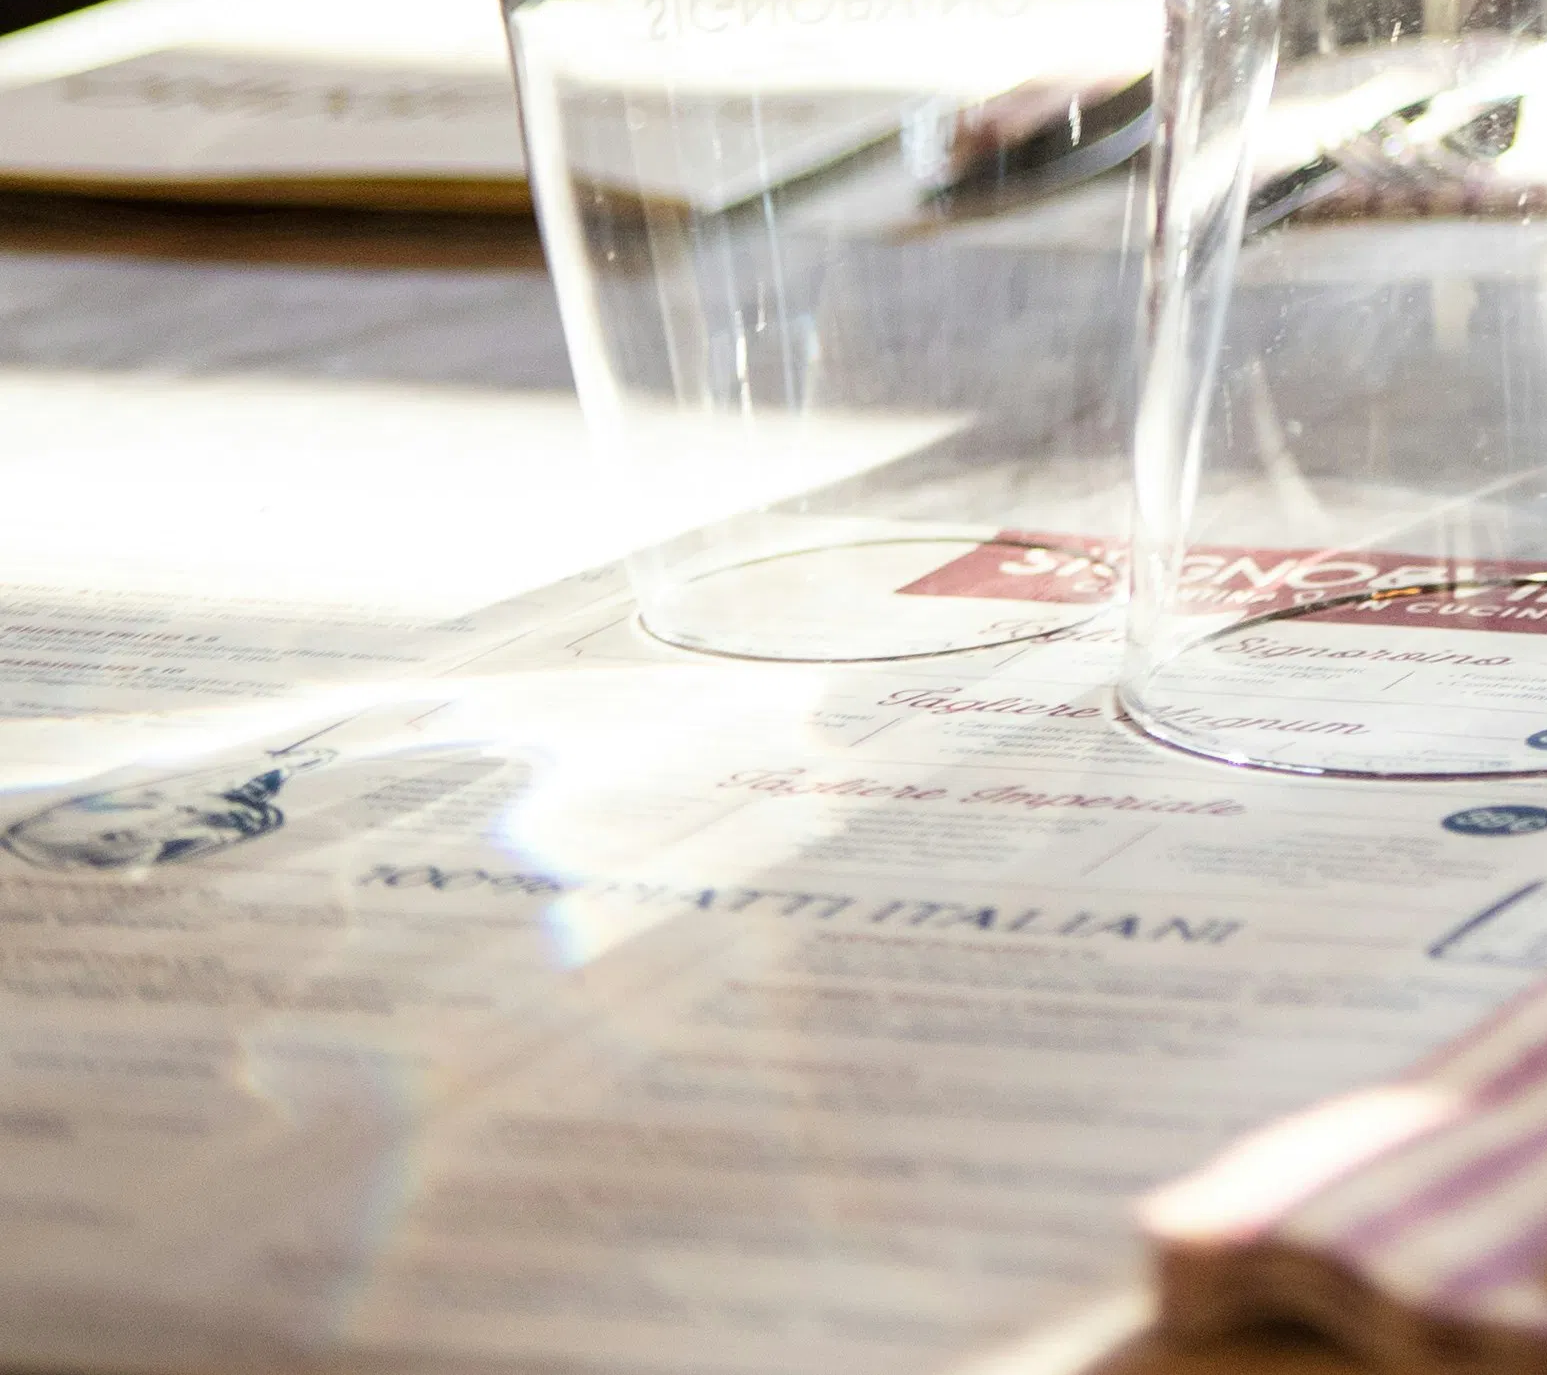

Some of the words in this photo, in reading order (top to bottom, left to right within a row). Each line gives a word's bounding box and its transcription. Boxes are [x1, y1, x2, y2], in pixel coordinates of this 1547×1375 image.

[877, 686, 1102, 717] Tagliere
[716, 767, 948, 800] Tagliere
[959, 784, 1246, 816] Imperiale
[868, 896, 1248, 946] ITALIANI
